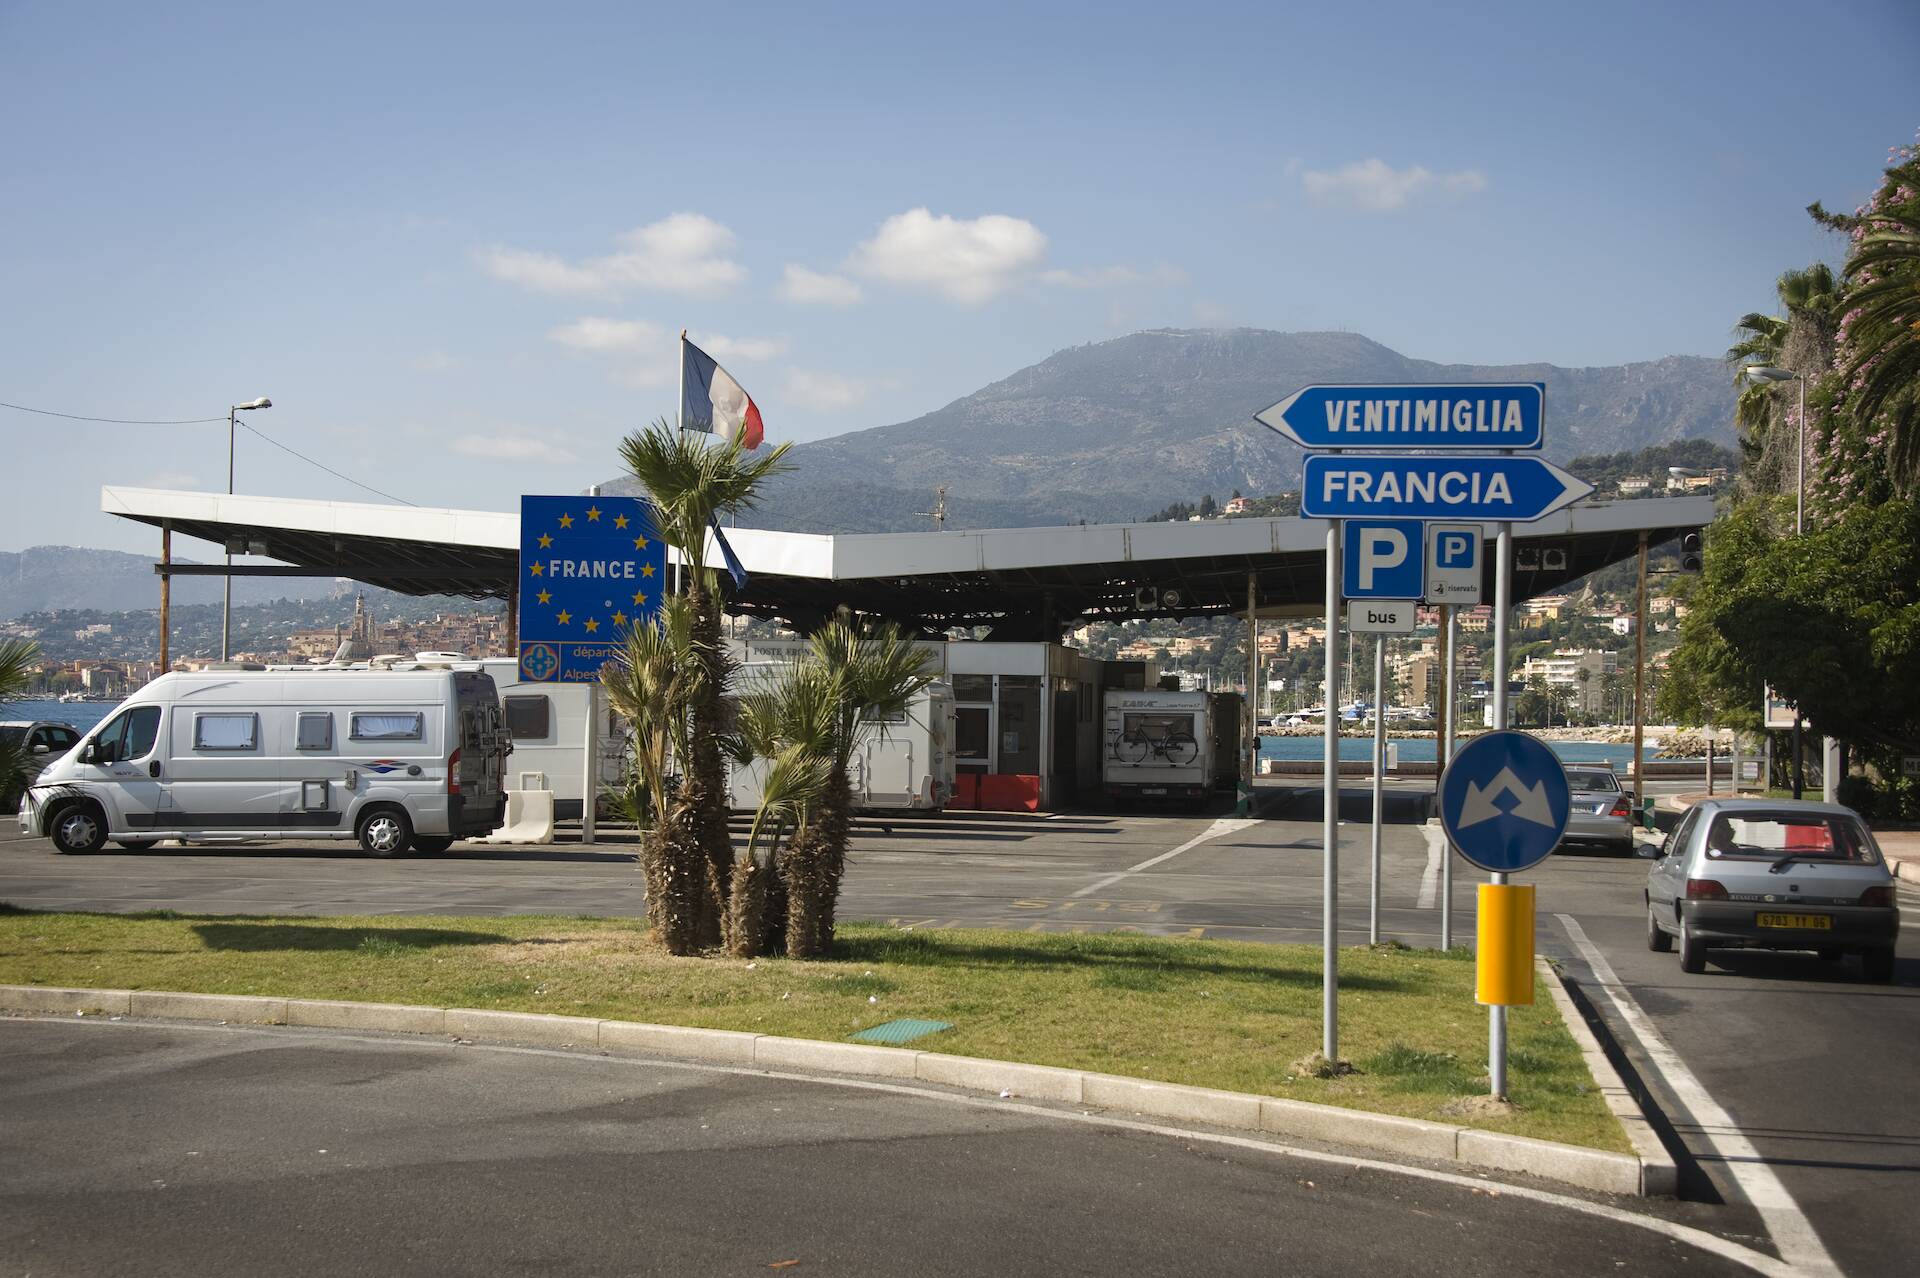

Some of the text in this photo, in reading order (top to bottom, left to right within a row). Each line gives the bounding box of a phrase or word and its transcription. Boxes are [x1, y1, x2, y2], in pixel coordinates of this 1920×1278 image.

[1325, 399, 1523, 433] VENTIMIGLIA
[1322, 471, 1513, 505] FRANCIA
[1358, 527, 1409, 590] P
[1444, 536, 1467, 564] P
[549, 559, 636, 579] FRANCE
[1447, 584, 1478, 593] riservato
[1367, 610, 1397, 624] bus
[754, 647, 782, 656] POSTE
